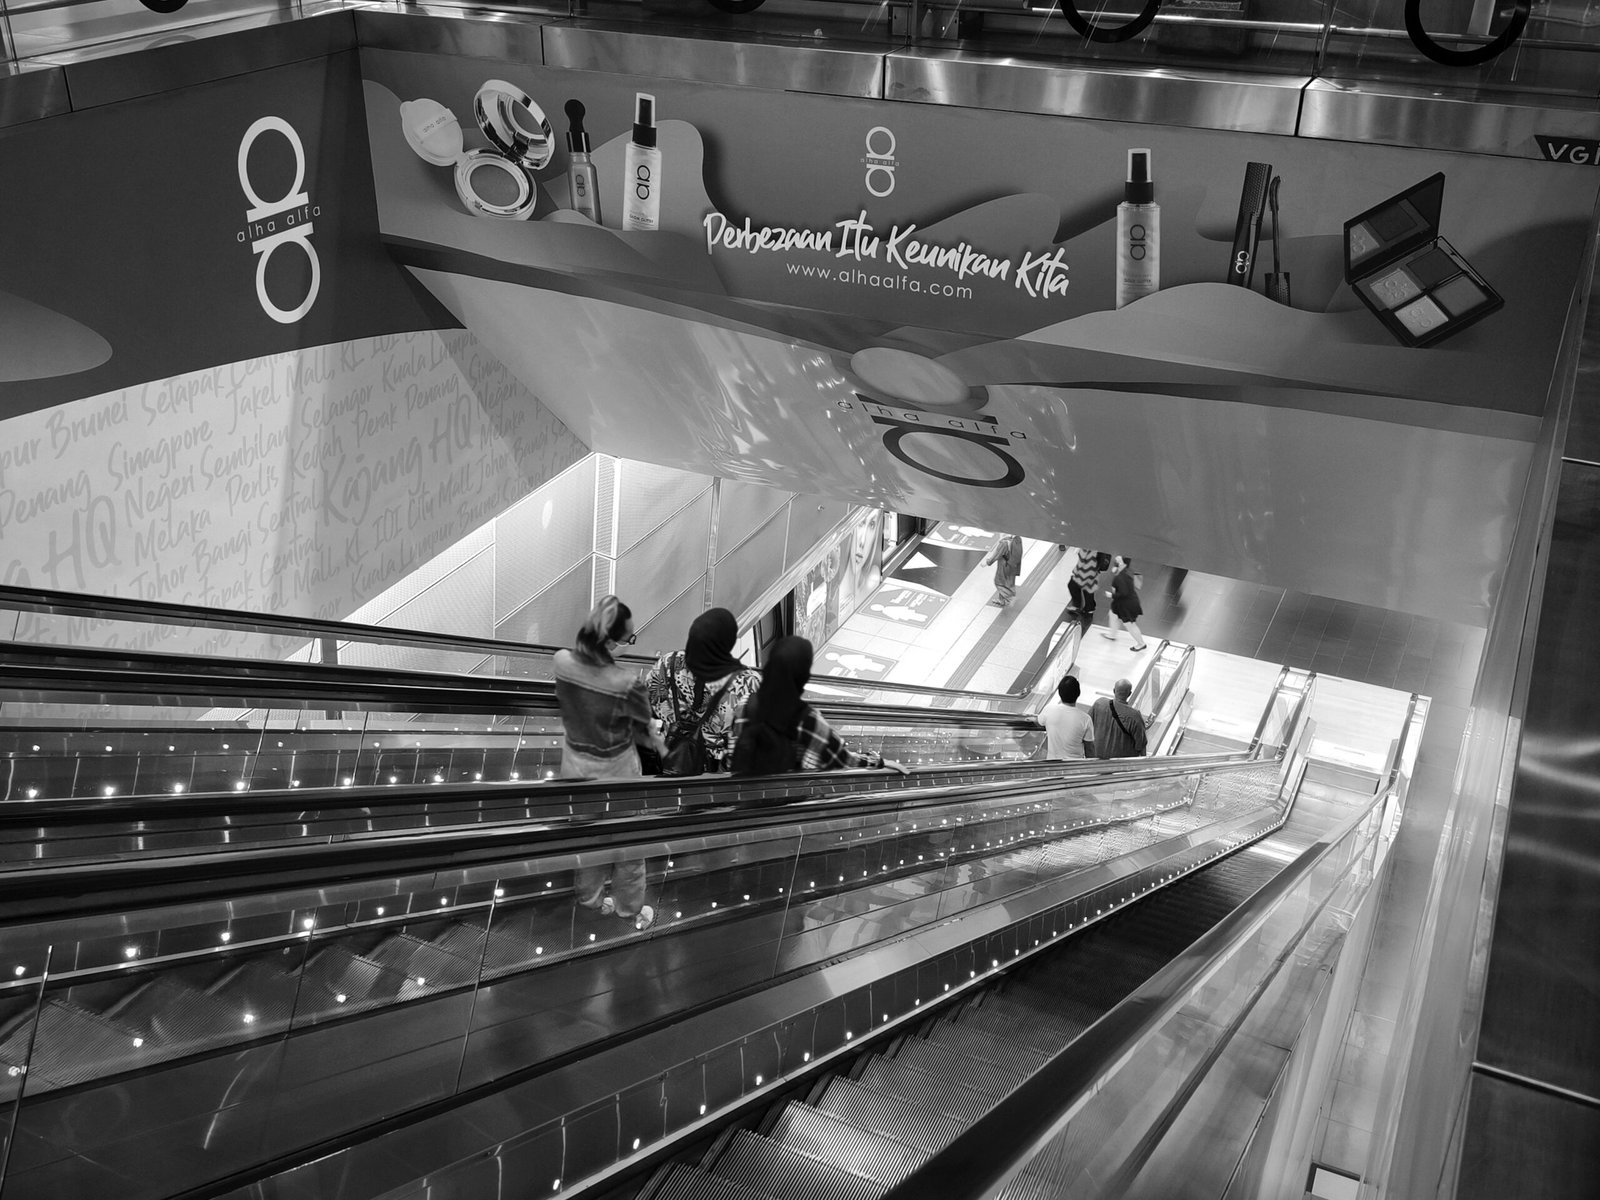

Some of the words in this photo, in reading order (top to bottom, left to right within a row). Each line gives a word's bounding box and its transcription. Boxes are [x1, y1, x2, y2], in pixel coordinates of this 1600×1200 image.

[236, 220, 276, 242] alha
[286, 205, 321, 226] alfa
[703, 212, 833, 255] Perbezaan
[835, 210, 881, 261] Itu
[886, 224, 1011, 281] Keunikan
[1014, 248, 1070, 298] Kita
[786, 262, 973, 300] www.alhaalfa.com
[45, 391, 128, 460] Brunei
[428, 394, 473, 464] HQ
[837, 399, 920, 422] alha
[948, 419, 1027, 440] alfa
[41, 495, 122, 590] HQ
[125, 464, 195, 528] Negeri
[200, 424, 290, 491] Sembilan
[382, 346, 426, 392] Kuala
[135, 508, 212, 566] Melaka
[225, 463, 279, 516] Perlis
[352, 403, 397, 448] Perak
[404, 373, 459, 420] Penang
[192, 521, 251, 582] Bangi
[344, 528, 368, 567] KL
